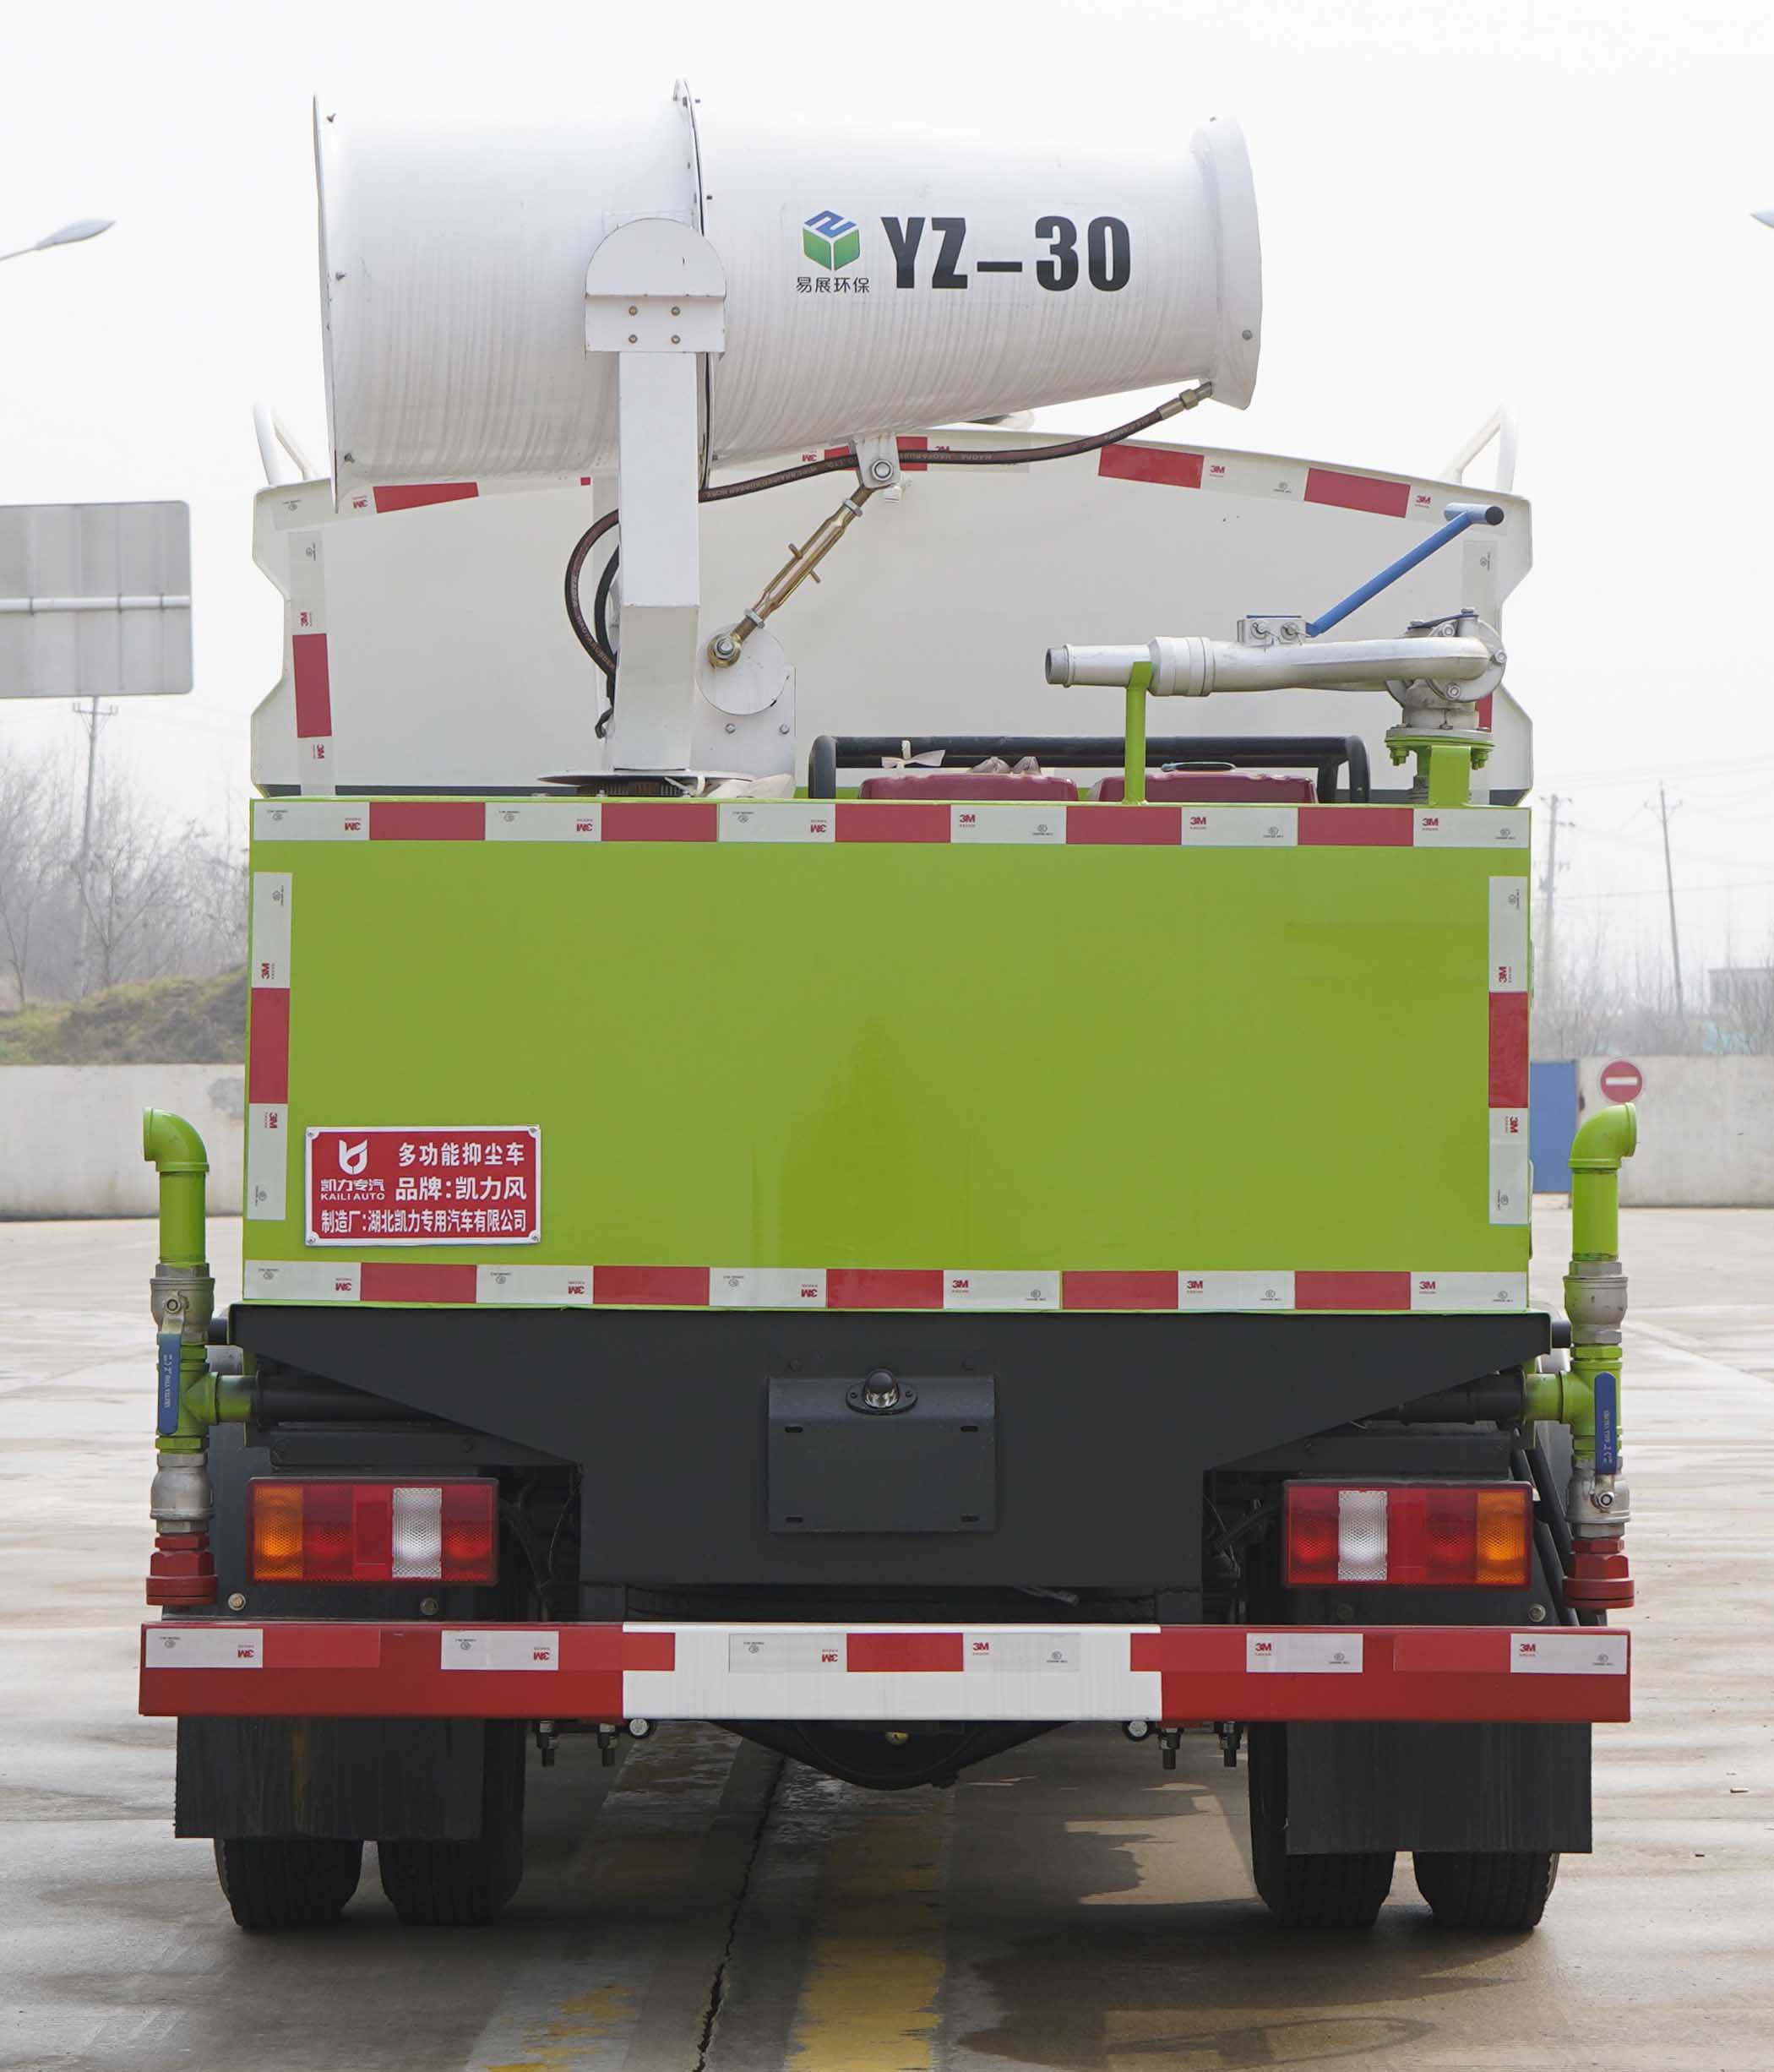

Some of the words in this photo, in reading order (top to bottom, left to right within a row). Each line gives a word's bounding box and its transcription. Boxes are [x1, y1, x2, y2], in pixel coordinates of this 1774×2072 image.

[795, 276, 870, 293] 易展环保
[801, 453, 817, 463] 3M
[1210, 465, 1226, 474] 3M
[352, 499, 367, 509] 3M
[1416, 495, 1431, 504] 3M
[300, 612, 309, 627] 3M
[316, 744, 325, 759] 3M
[959, 813, 976, 824] 3M
[1189, 816, 1207, 825] 3M
[1422, 818, 1439, 827] 3M
[344, 822, 361, 831] 3M
[576, 823, 593, 832] 3M
[810, 824, 827, 833] 3M
[261, 962, 270, 980] 3M
[1498, 965, 1508, 983] 3M
[269, 1112, 278, 1129] 3M
[1509, 1117, 1519, 1134] 3M
[398, 1142, 525, 1167] 多功能抑尘车
[320, 1179, 385, 1192] 凯力专汽
[395, 1177, 527, 1201] 品牌:凯力风
[321, 1210, 526, 1233] 制造厂:湖北凯力专用汽车有限公司
[335, 1282, 352, 1292] 3M
[952, 1280, 969, 1289] 3M
[1187, 1280, 1204, 1290] 3M
[1419, 1281, 1436, 1290] 3M
[568, 1286, 585, 1295] 3M
[801, 1288, 818, 1298] 3M
[972, 1642, 990, 1651] 3M
[1255, 1642, 1272, 1652] 3M
[1520, 1643, 1537, 1653] 3M
[237, 1649, 254, 1658] 3M
[533, 1651, 550, 1661] 3M
[821, 1653, 838, 1663] 3M
